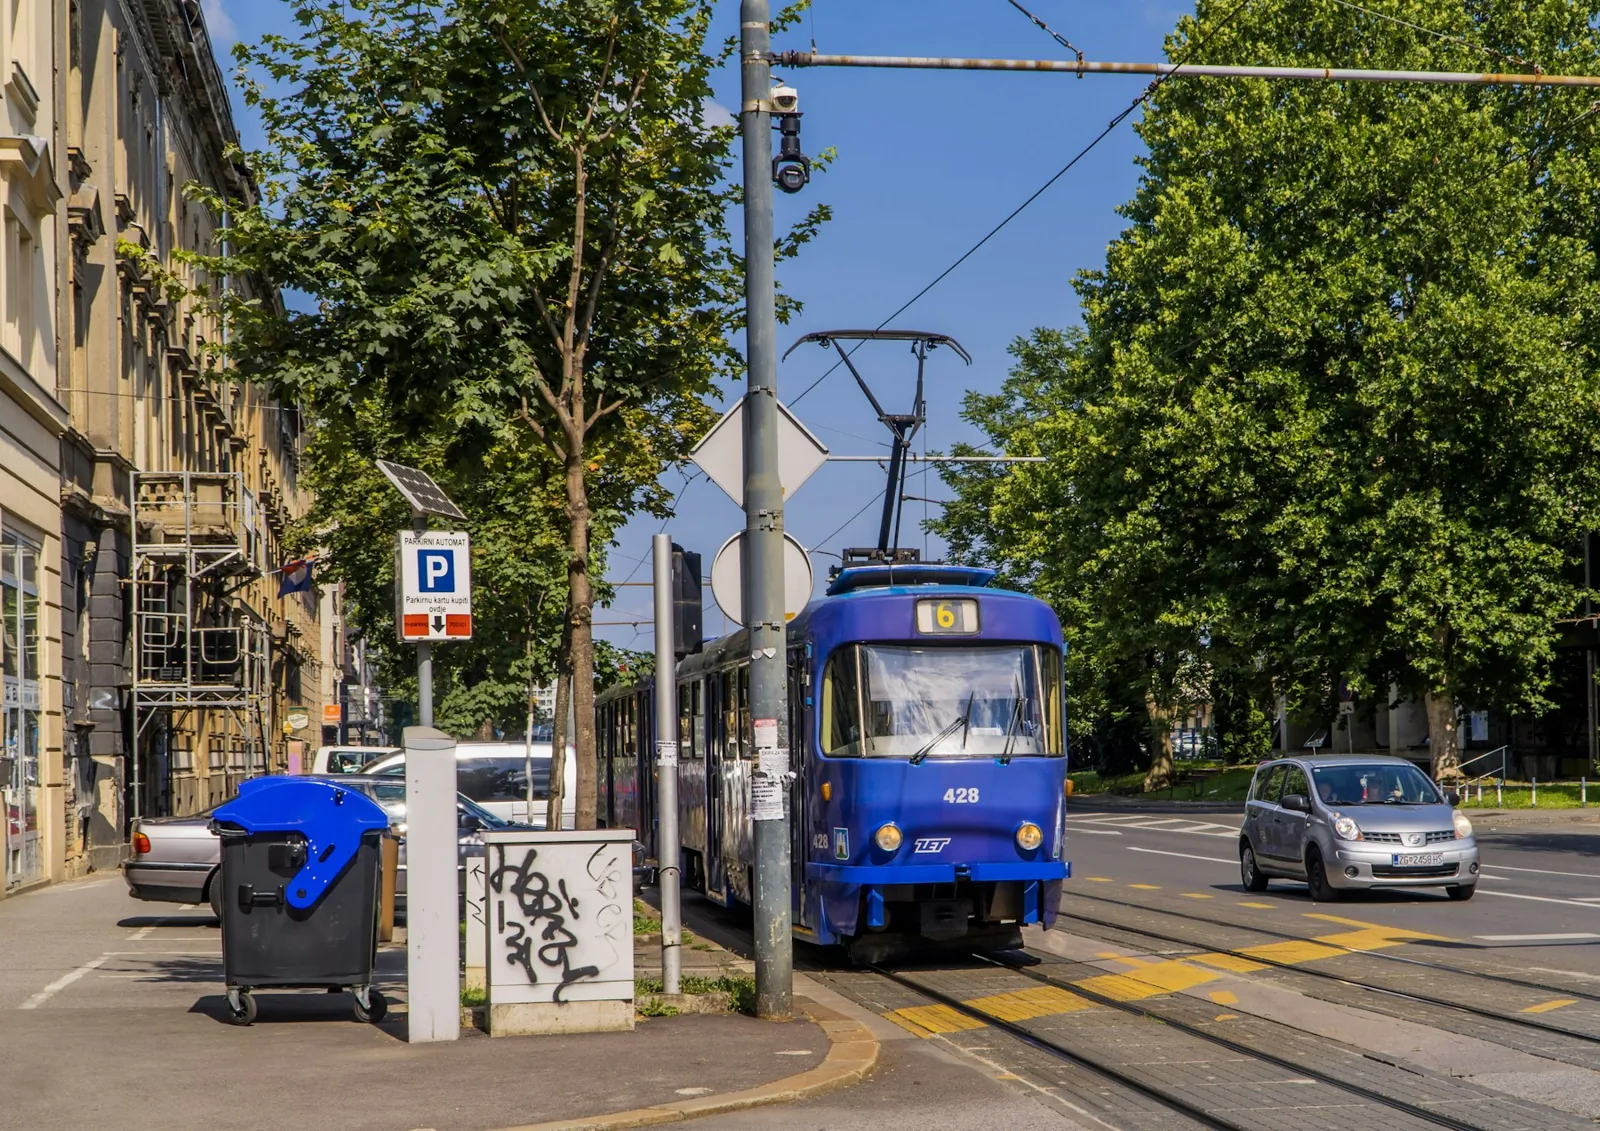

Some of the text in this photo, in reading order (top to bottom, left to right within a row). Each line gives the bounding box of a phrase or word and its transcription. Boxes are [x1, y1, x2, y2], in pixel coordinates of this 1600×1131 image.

[404, 537, 466, 546] PARKIRNI AUTOMAT
[426, 555, 448, 588] P
[405, 596, 469, 605] Parkirnu kartu kupiti
[429, 605, 446, 614] ovdje
[937, 601, 954, 628] 6
[943, 787, 979, 804] 428
[813, 833, 828, 849] 428
[914, 837, 951, 853] ZET
